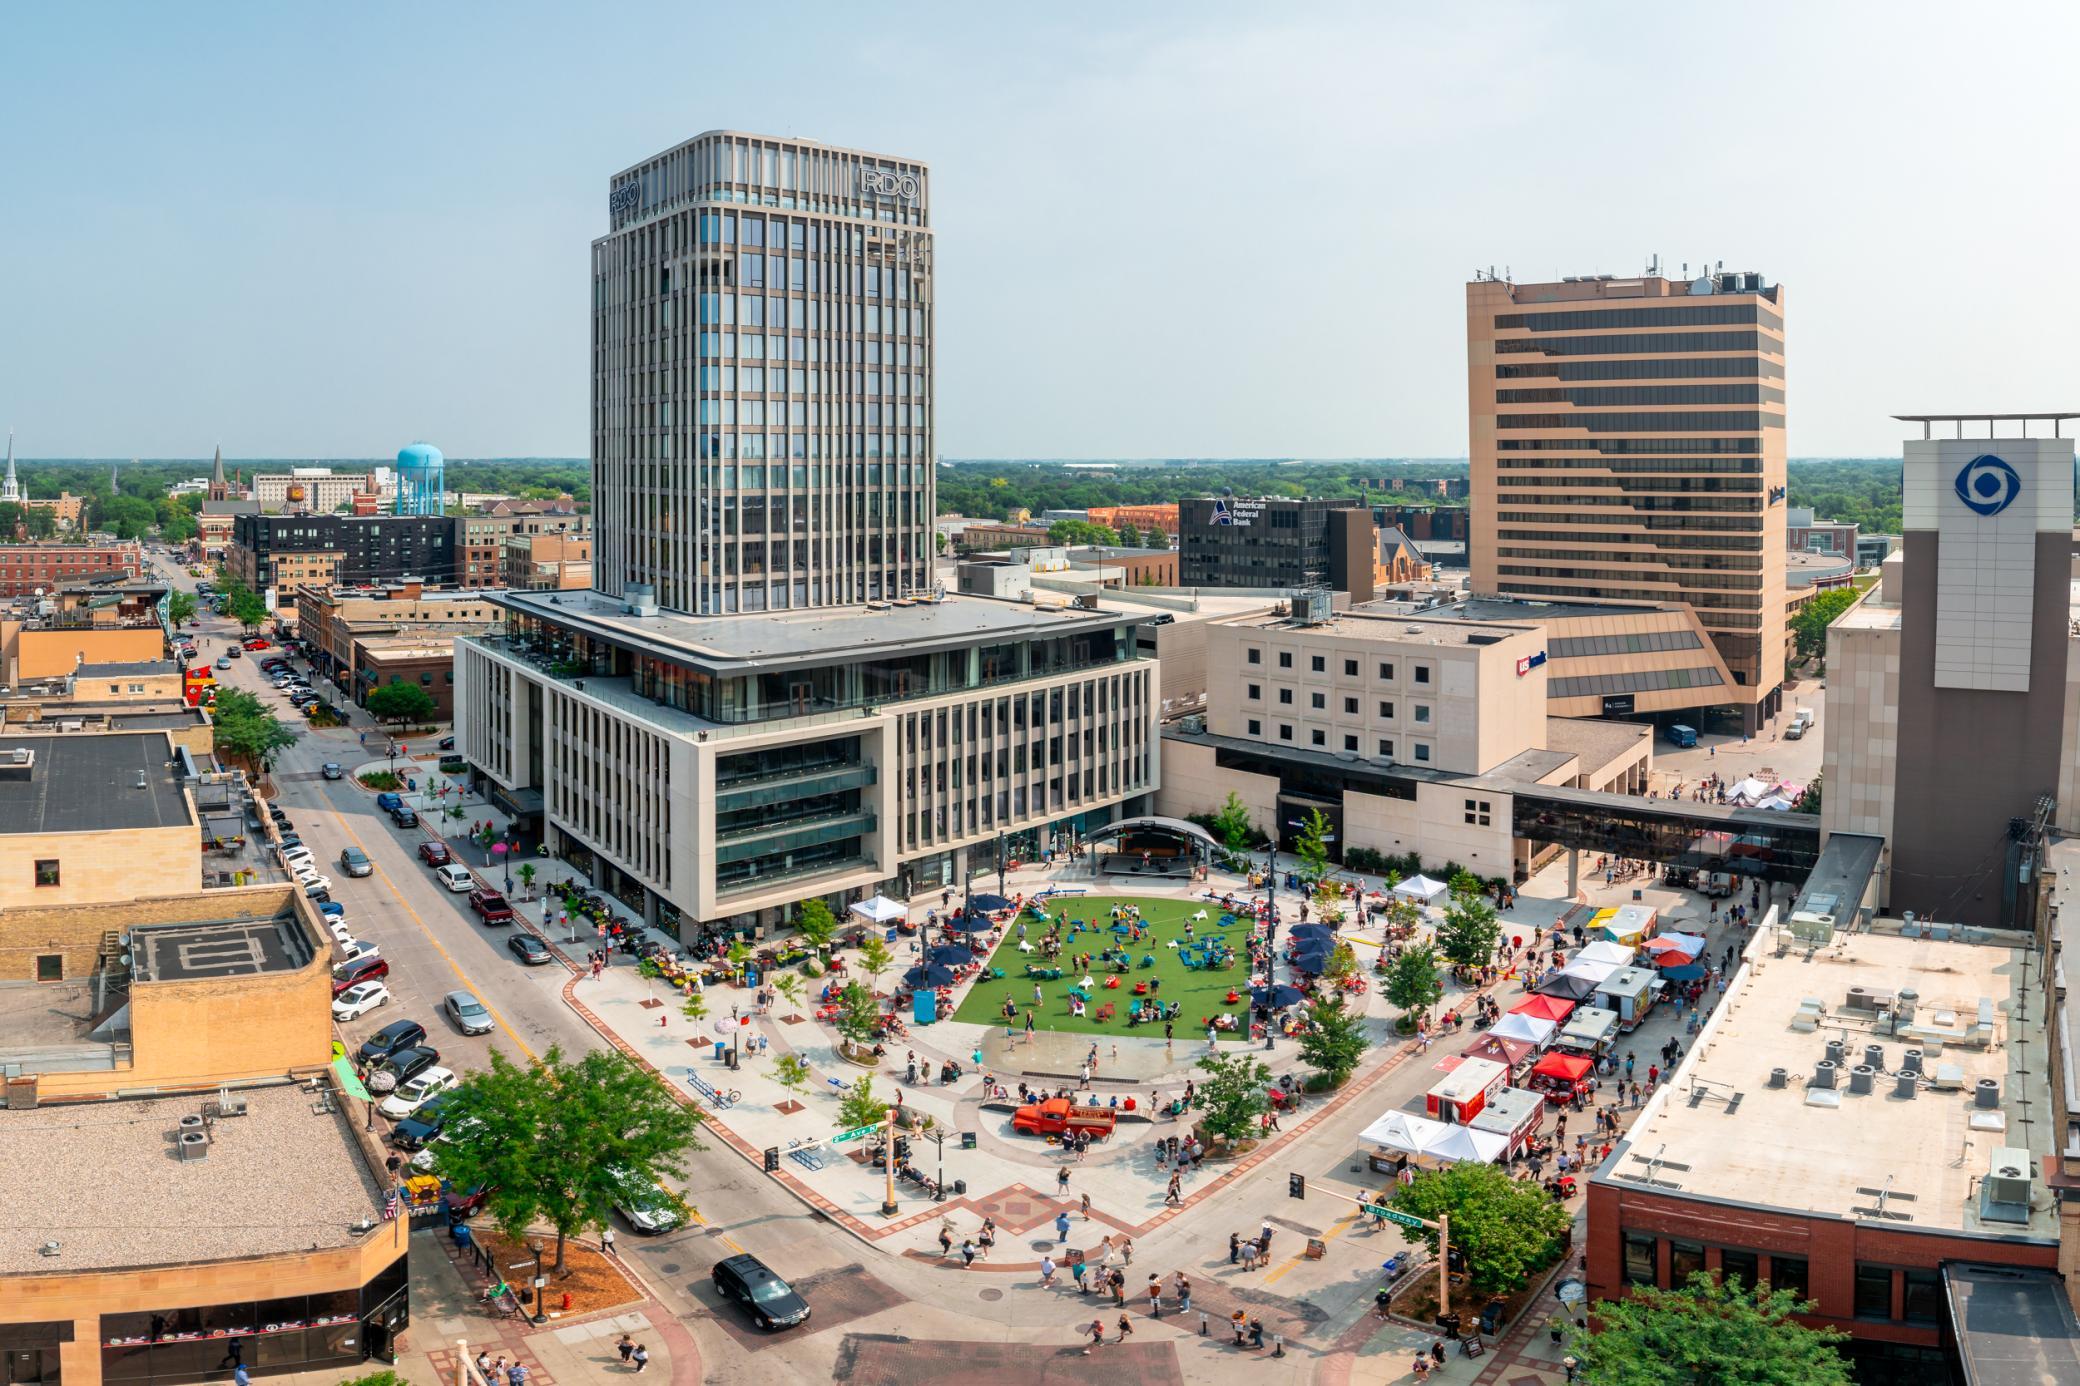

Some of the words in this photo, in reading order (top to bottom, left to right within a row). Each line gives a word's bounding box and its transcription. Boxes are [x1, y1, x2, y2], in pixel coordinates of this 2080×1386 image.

[860, 169, 919, 200] RDO
[610, 181, 640, 215] RDO
[1233, 501, 1266, 509] American
[1233, 510, 1259, 518] Federal
[1233, 518, 1251, 526] Bank
[851, 1129, 866, 1138] Ave
[408, 1205, 439, 1217] VFW
[1369, 1206, 1418, 1226] Broadway
